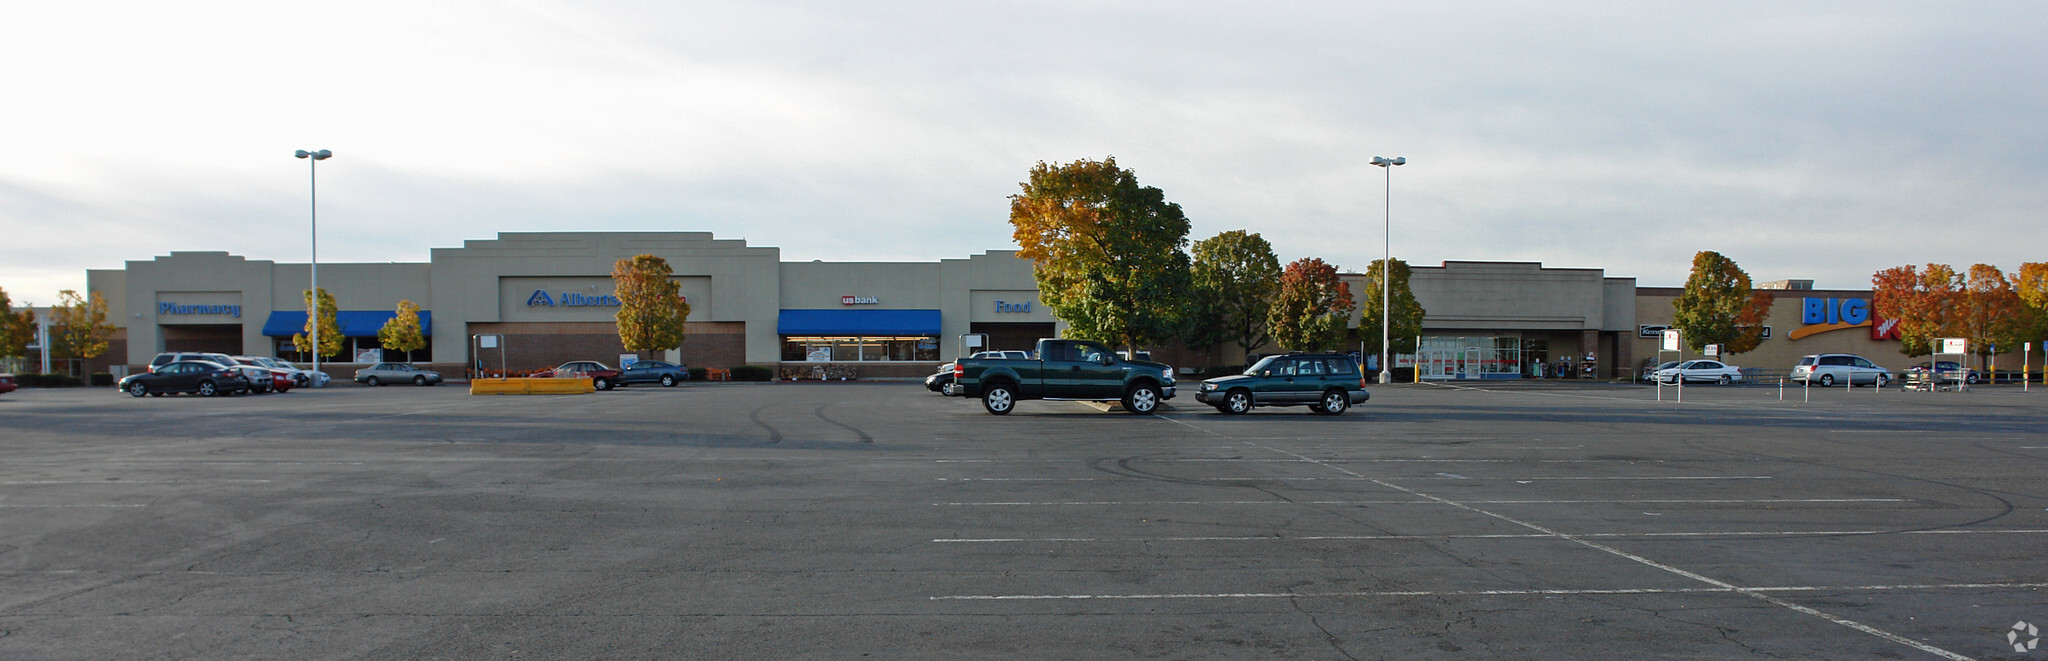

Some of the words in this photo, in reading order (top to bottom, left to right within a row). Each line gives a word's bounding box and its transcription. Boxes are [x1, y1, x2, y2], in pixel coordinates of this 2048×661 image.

[560, 292, 623, 307] Alberts
[995, 300, 1031, 313] Food
[159, 301, 241, 318] Pharmacy
[1802, 297, 1869, 325] BIG
